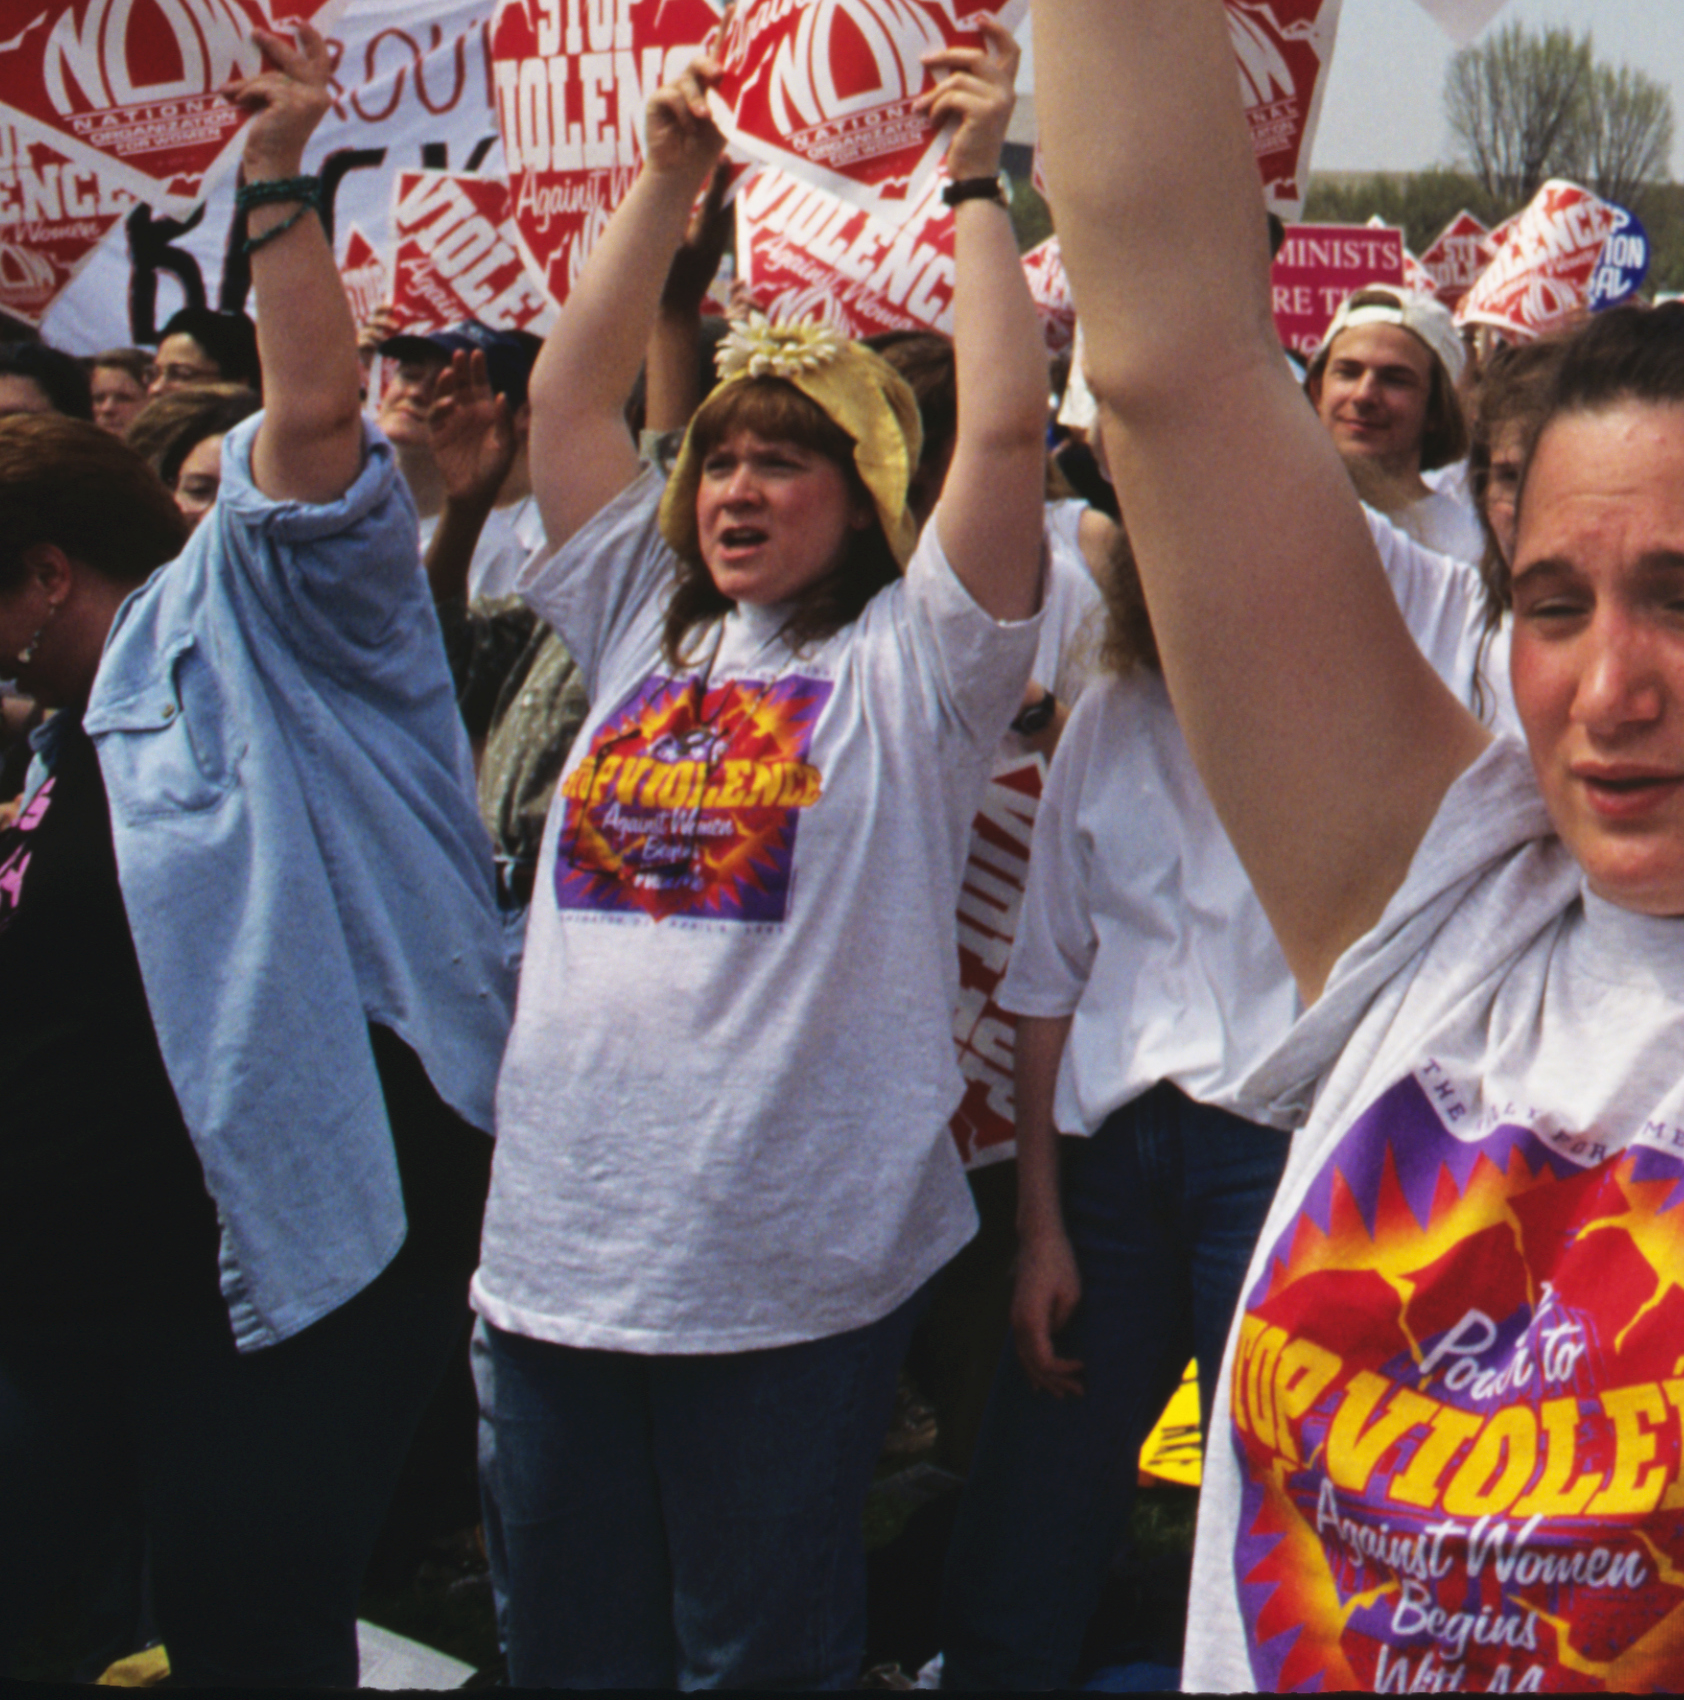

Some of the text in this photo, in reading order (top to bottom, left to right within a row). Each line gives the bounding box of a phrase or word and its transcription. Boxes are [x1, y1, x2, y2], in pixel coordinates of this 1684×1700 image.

[90, 110, 239, 145] ORGANIZATION
[115, 127, 222, 154] FOR WOMEN
[515, 160, 609, 233] Against
[1422, 1057, 1467, 1123] THE
[1541, 1318, 1585, 1382] to
[1315, 1478, 1648, 1590] Against Women
[1390, 1579, 1537, 1661] Begins
